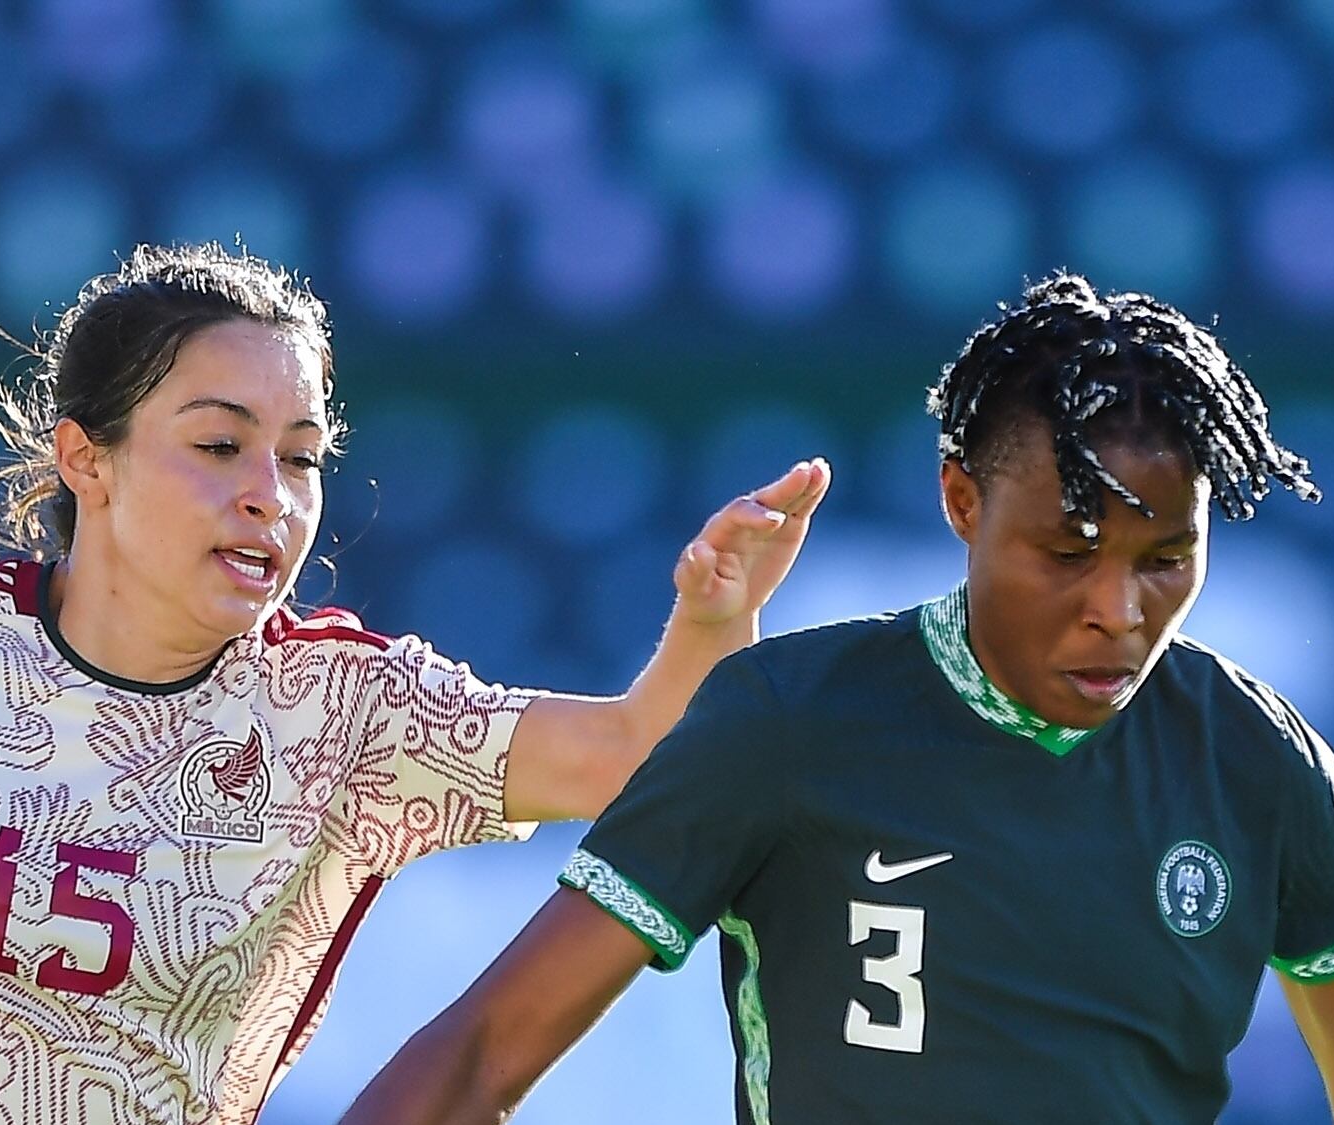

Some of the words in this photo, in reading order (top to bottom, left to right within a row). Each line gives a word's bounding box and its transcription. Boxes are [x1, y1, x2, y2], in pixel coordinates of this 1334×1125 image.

[1165, 846, 1207, 873] FOOTBALL
[1206, 855, 1227, 922] FEDERATION
[844, 899, 926, 1054] 3
